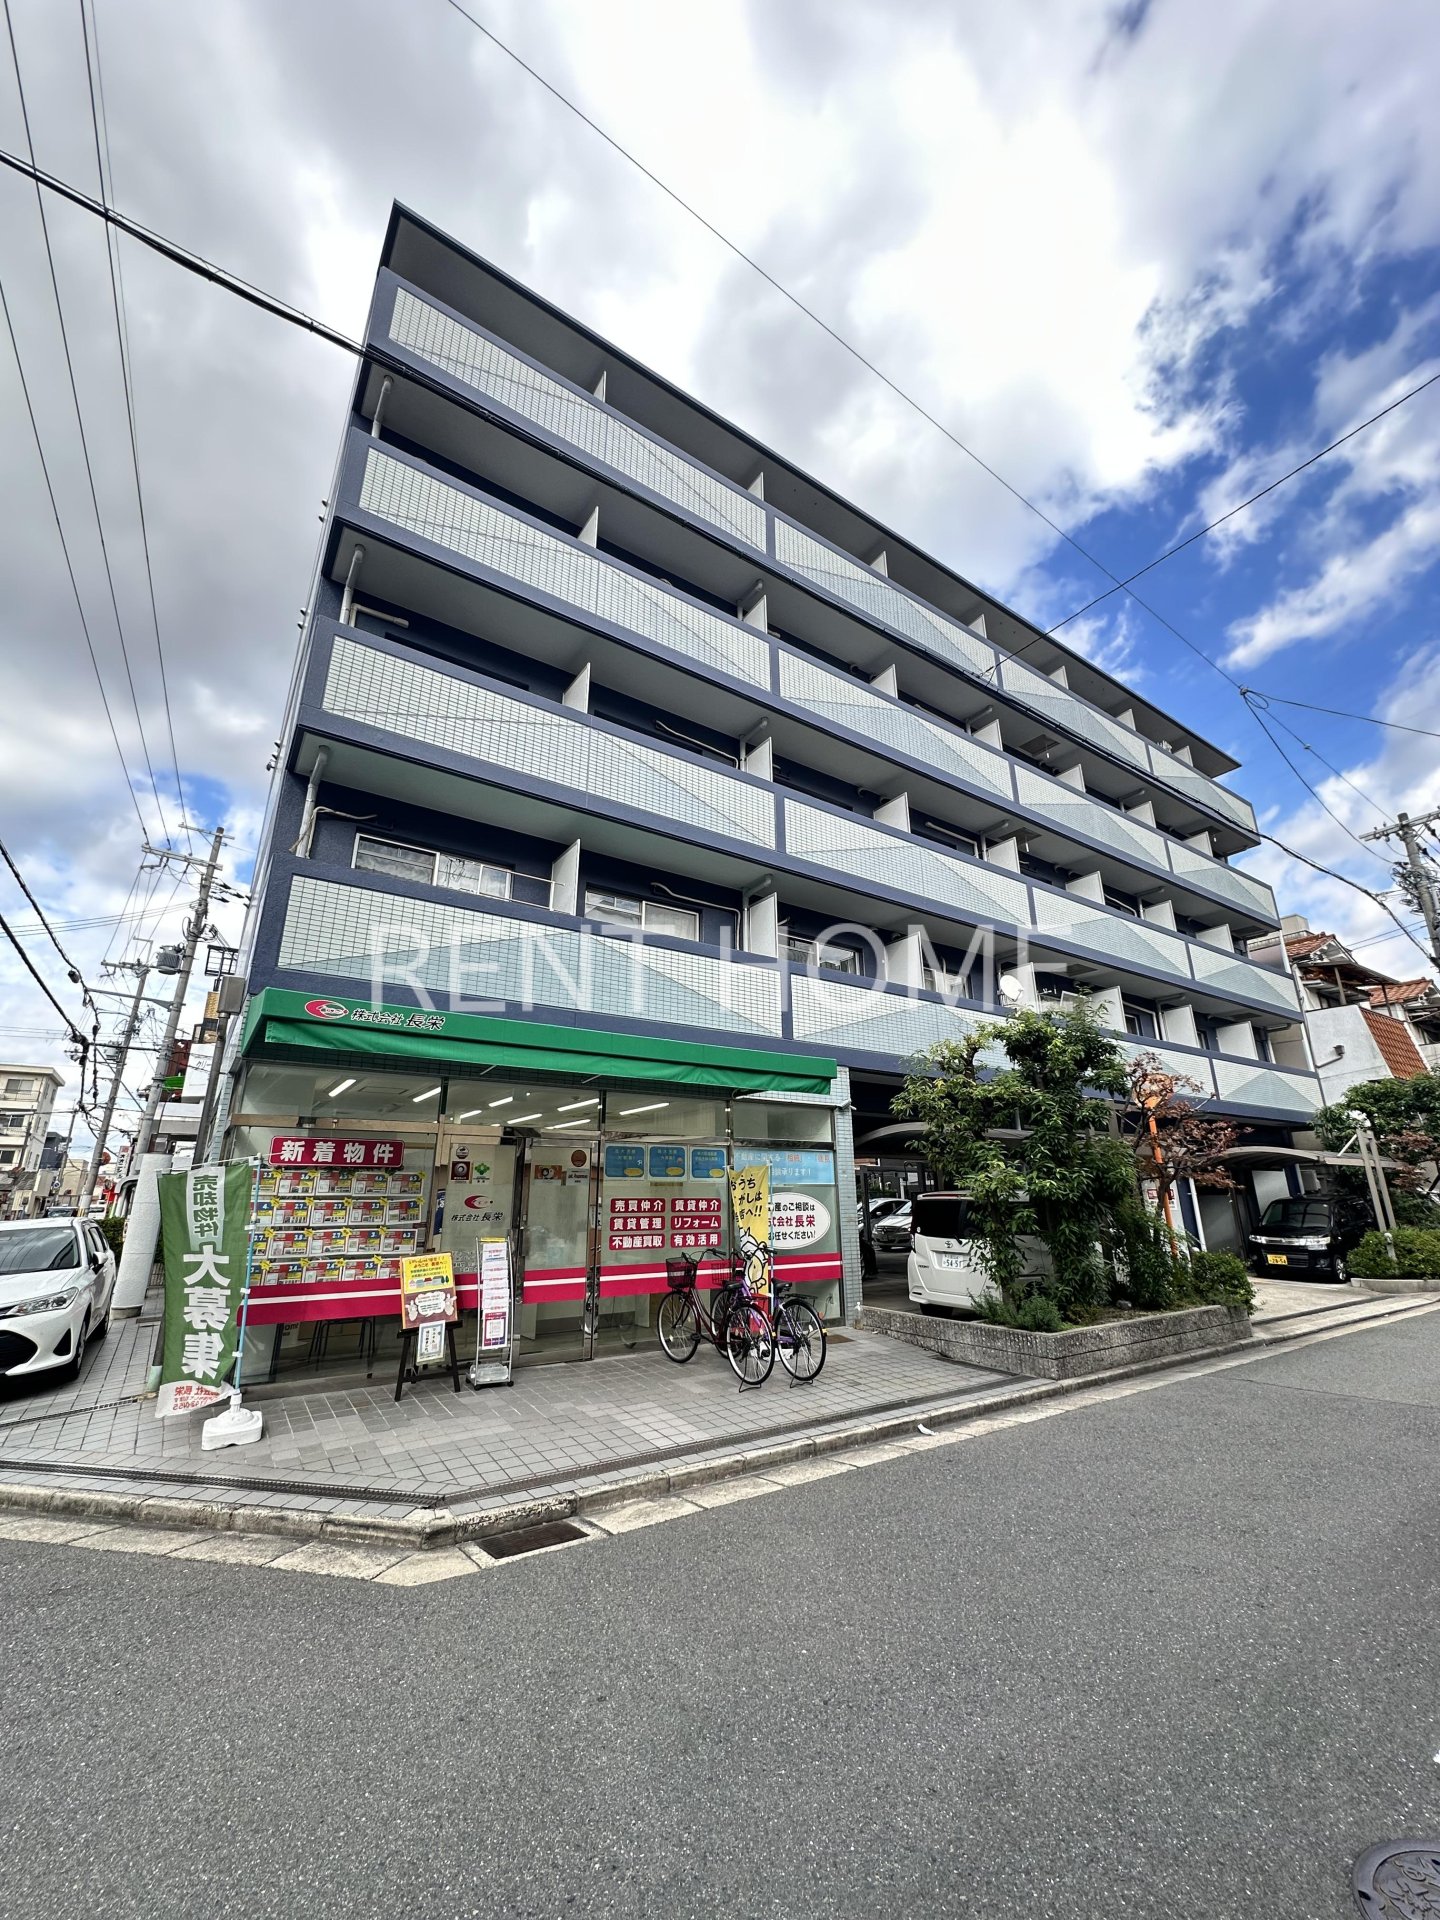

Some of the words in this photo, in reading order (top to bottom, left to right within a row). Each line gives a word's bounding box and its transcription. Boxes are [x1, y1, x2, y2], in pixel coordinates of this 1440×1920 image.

[280, 1140, 394, 1164] 新着物件
[615, 1200, 663, 1212] 売買仲介
[675, 1200, 719, 1211] 賃貸仲介
[613, 1217, 662, 1230] 賃貸管理
[674, 1217, 719, 1228] リフォーム
[612, 1235, 662, 1249] 不動産買取
[674, 1234, 718, 1247] 有効活用
